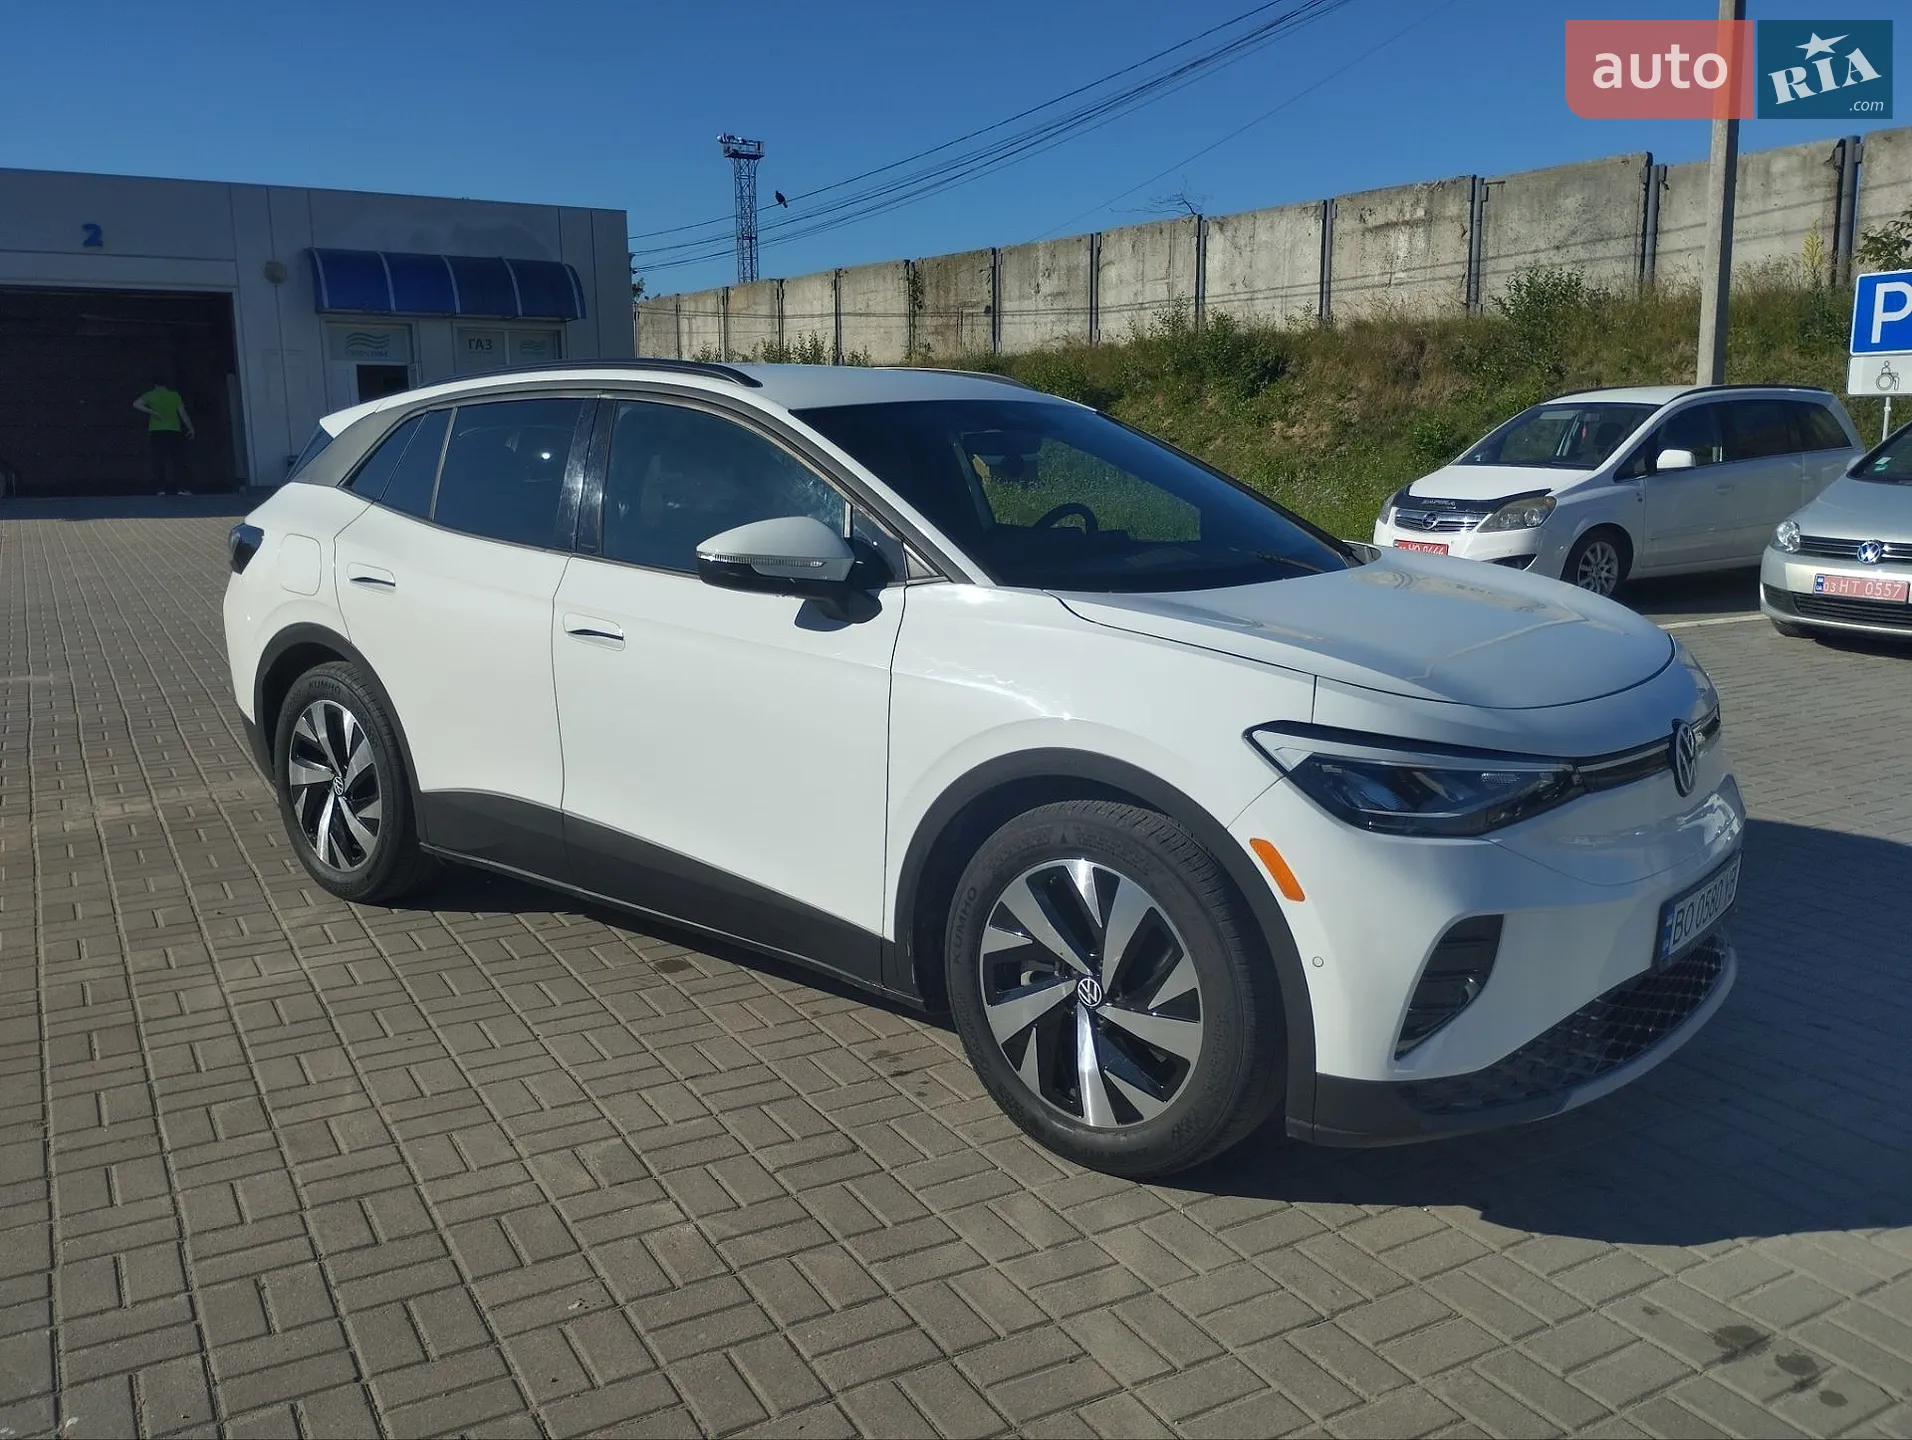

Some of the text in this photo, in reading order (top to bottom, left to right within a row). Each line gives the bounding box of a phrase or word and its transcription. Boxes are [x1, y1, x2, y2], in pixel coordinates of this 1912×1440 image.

[81, 223, 104, 248] 2
[1870, 281, 1912, 344] P
[468, 338, 494, 351] ГАЗ
[1823, 579, 1902, 598] 03 HT 0557
[952, 886, 978, 965] KUMHO
[1672, 900, 1695, 945] BO
